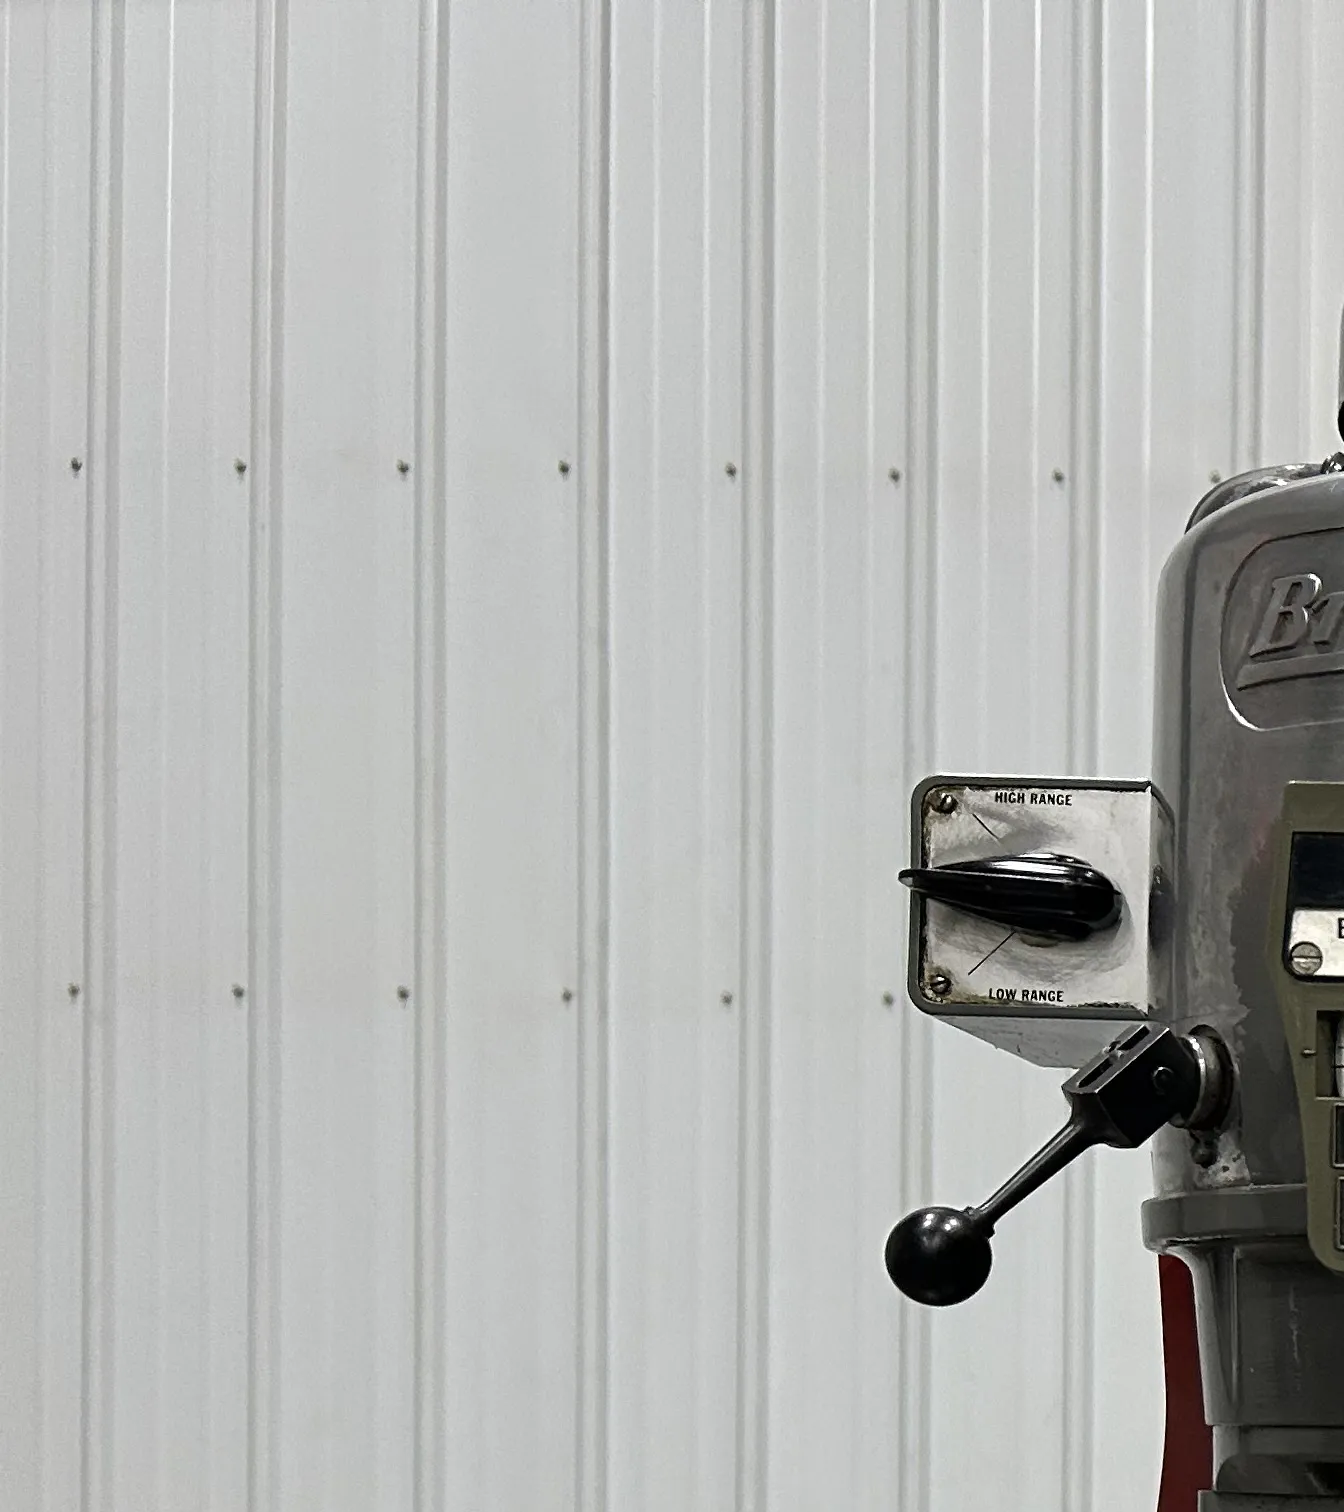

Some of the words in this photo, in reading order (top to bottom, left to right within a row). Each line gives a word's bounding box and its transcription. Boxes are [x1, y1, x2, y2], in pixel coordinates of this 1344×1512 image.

[994, 792, 1025, 804] HIGH
[1030, 793, 1073, 806] RANGE
[989, 988, 1017, 1000] LOW
[1021, 989, 1064, 1003] RANGE
